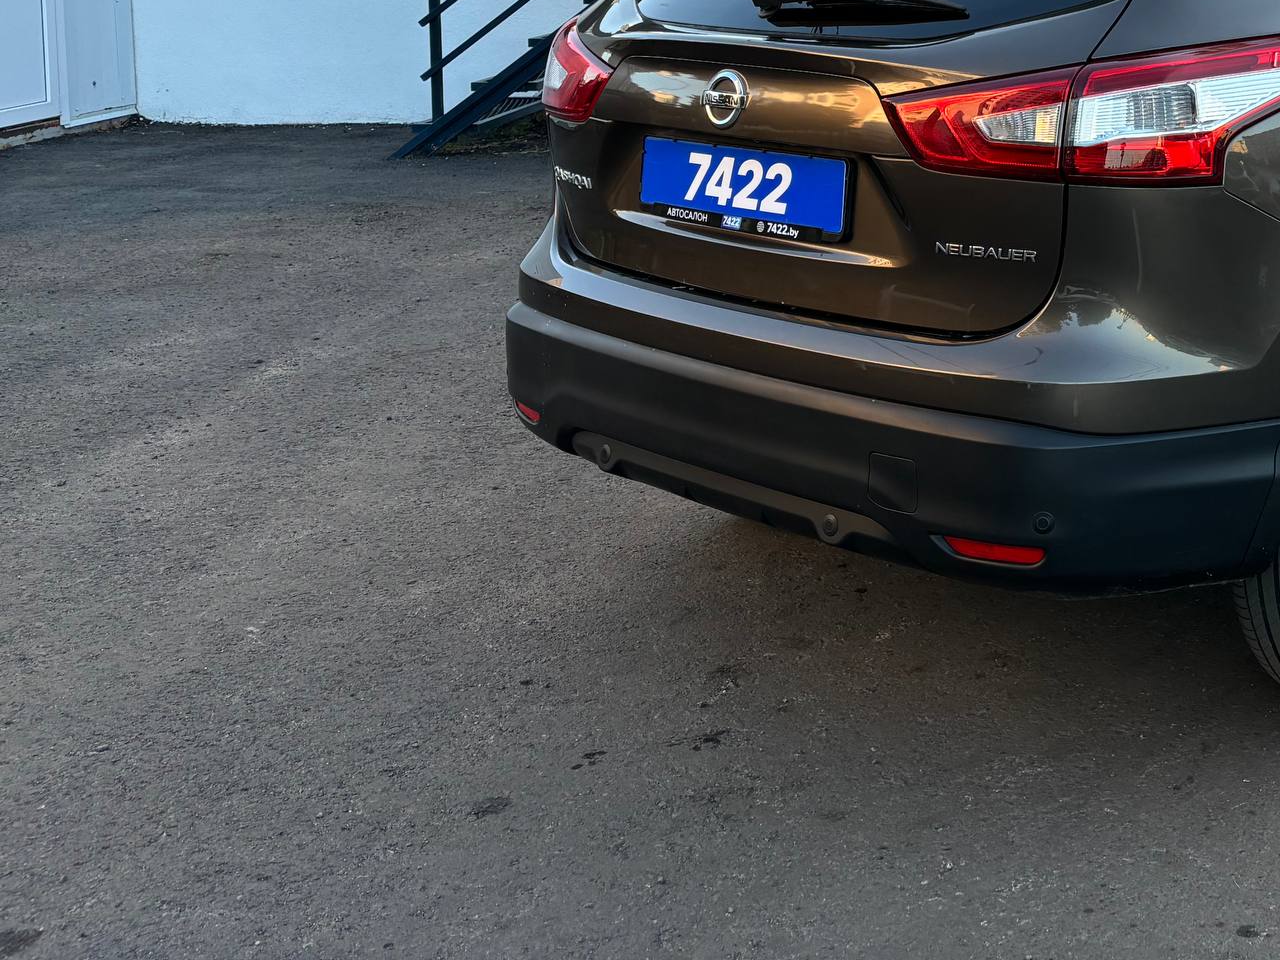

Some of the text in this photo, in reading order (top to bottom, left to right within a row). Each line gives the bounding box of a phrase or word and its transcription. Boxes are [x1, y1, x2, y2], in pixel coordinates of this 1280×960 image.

[704, 92, 739, 107] NISSAN
[684, 151, 793, 215] 7422
[666, 207, 709, 223] АВТОСАЛОН
[722, 215, 741, 227] 7422
[766, 222, 800, 239] 7422.by
[935, 241, 1037, 263] NEUBAUER
